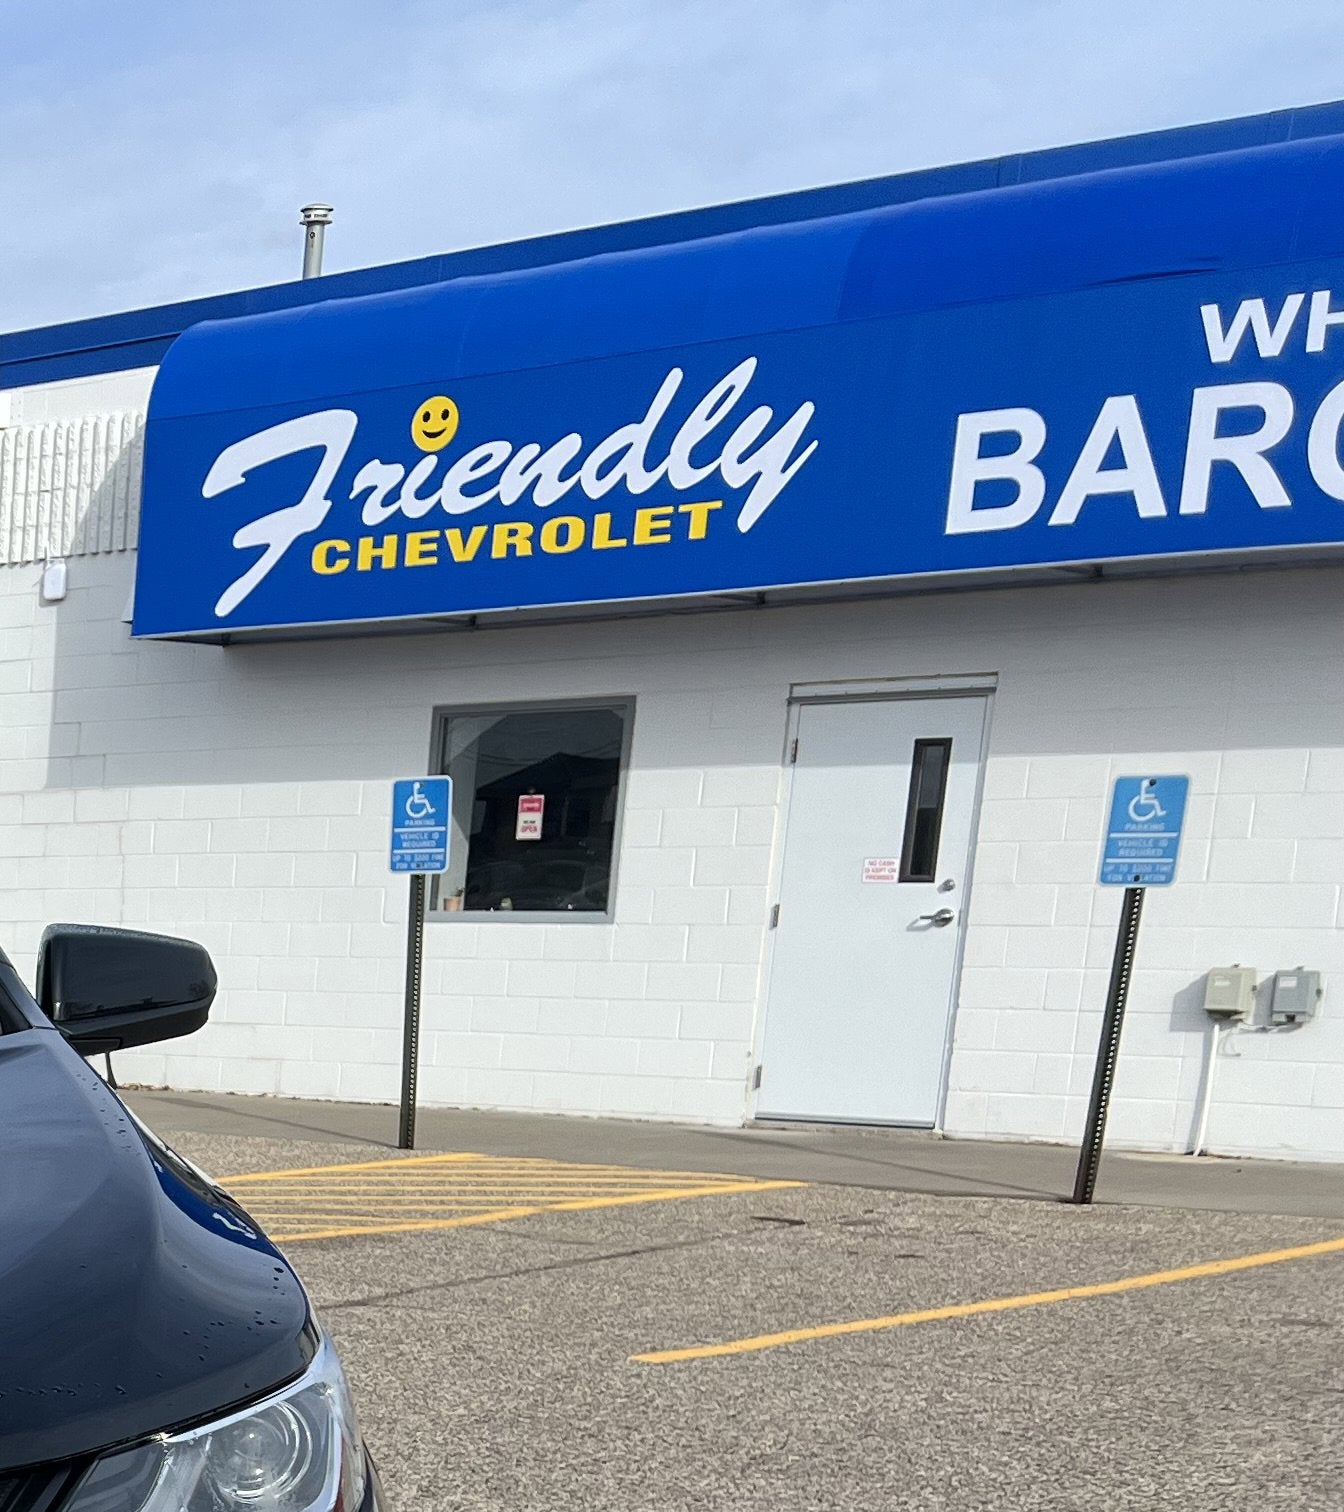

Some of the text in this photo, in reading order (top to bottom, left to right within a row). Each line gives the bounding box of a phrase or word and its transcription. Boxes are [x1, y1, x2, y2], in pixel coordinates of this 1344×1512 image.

[201, 356, 819, 617] Friendly
[312, 500, 722, 575] CHEVROLET
[405, 818, 435, 826] PARKING
[1124, 822, 1165, 831] PARKING
[400, 831, 439, 840] VEHICLE ID
[401, 840, 436, 848] REQUIRED
[1118, 838, 1168, 847] VEHICLE ID
[1118, 848, 1163, 857] REQUIRED
